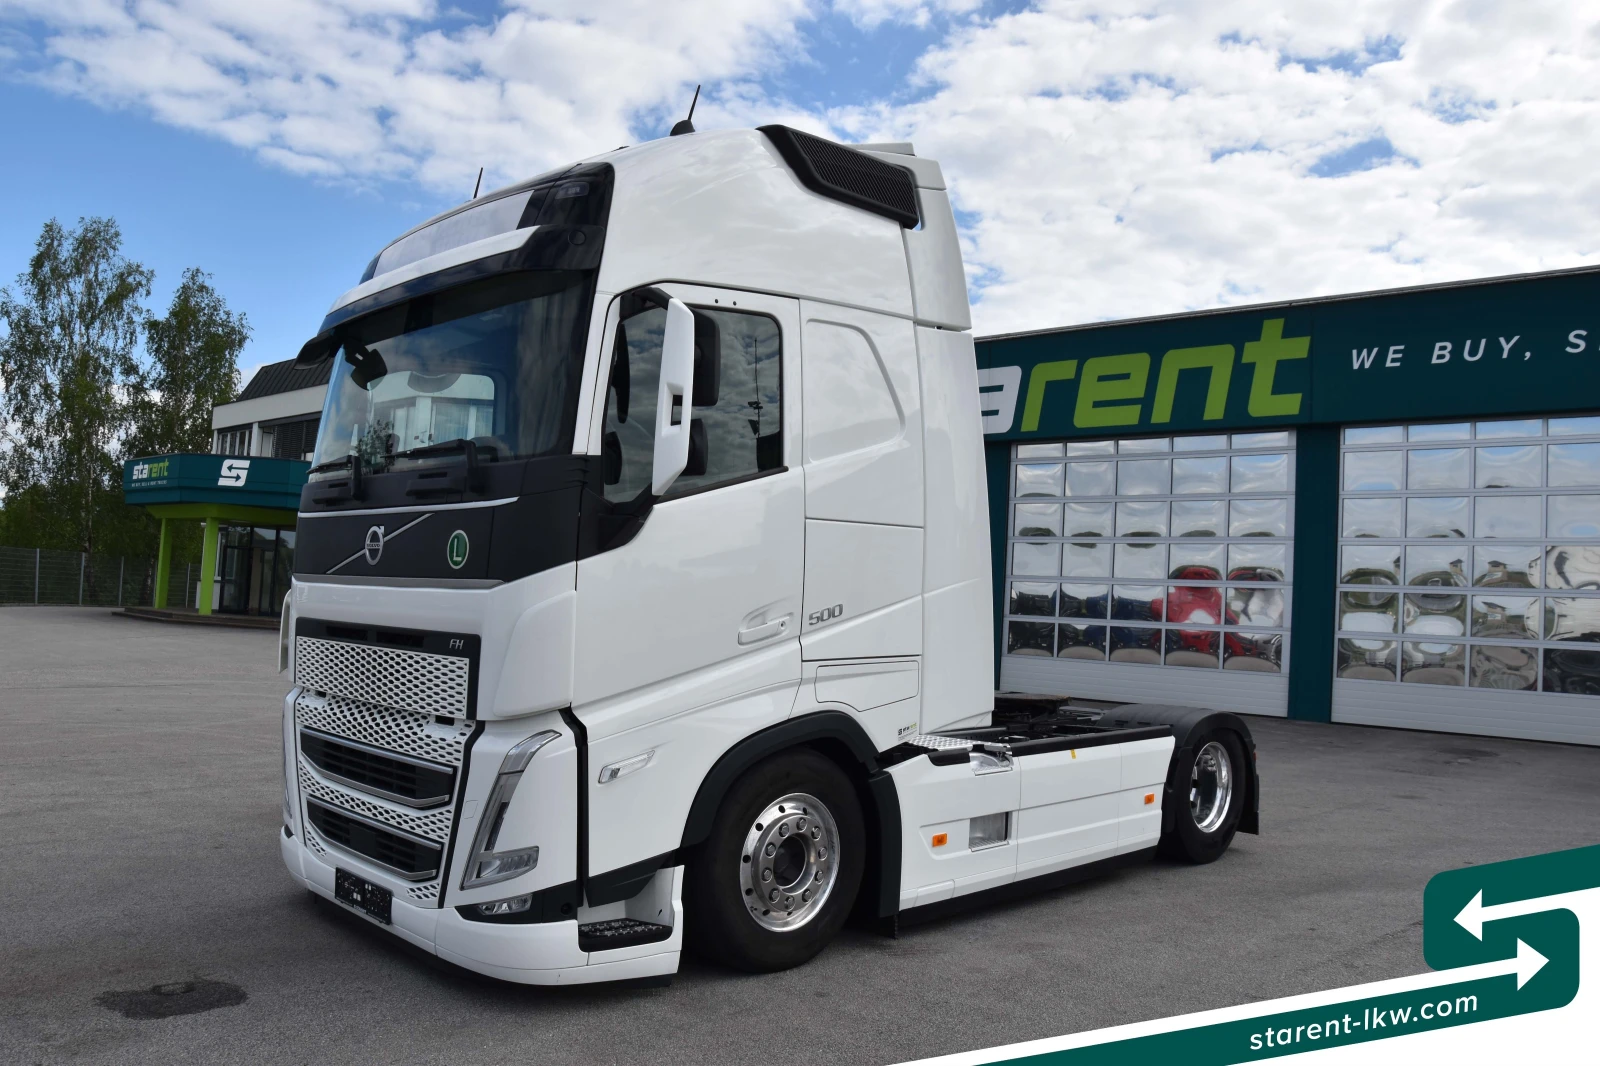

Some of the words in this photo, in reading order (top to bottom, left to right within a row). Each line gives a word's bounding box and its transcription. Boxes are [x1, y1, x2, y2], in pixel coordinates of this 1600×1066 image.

[1352, 345, 1405, 370] WE
[1431, 335, 1532, 364] BUY,
[1565, 329, 1600, 353] S
[132, 458, 169, 479] starent
[453, 538, 462, 561] L
[808, 603, 844, 626] 500
[449, 638, 464, 650] FH
